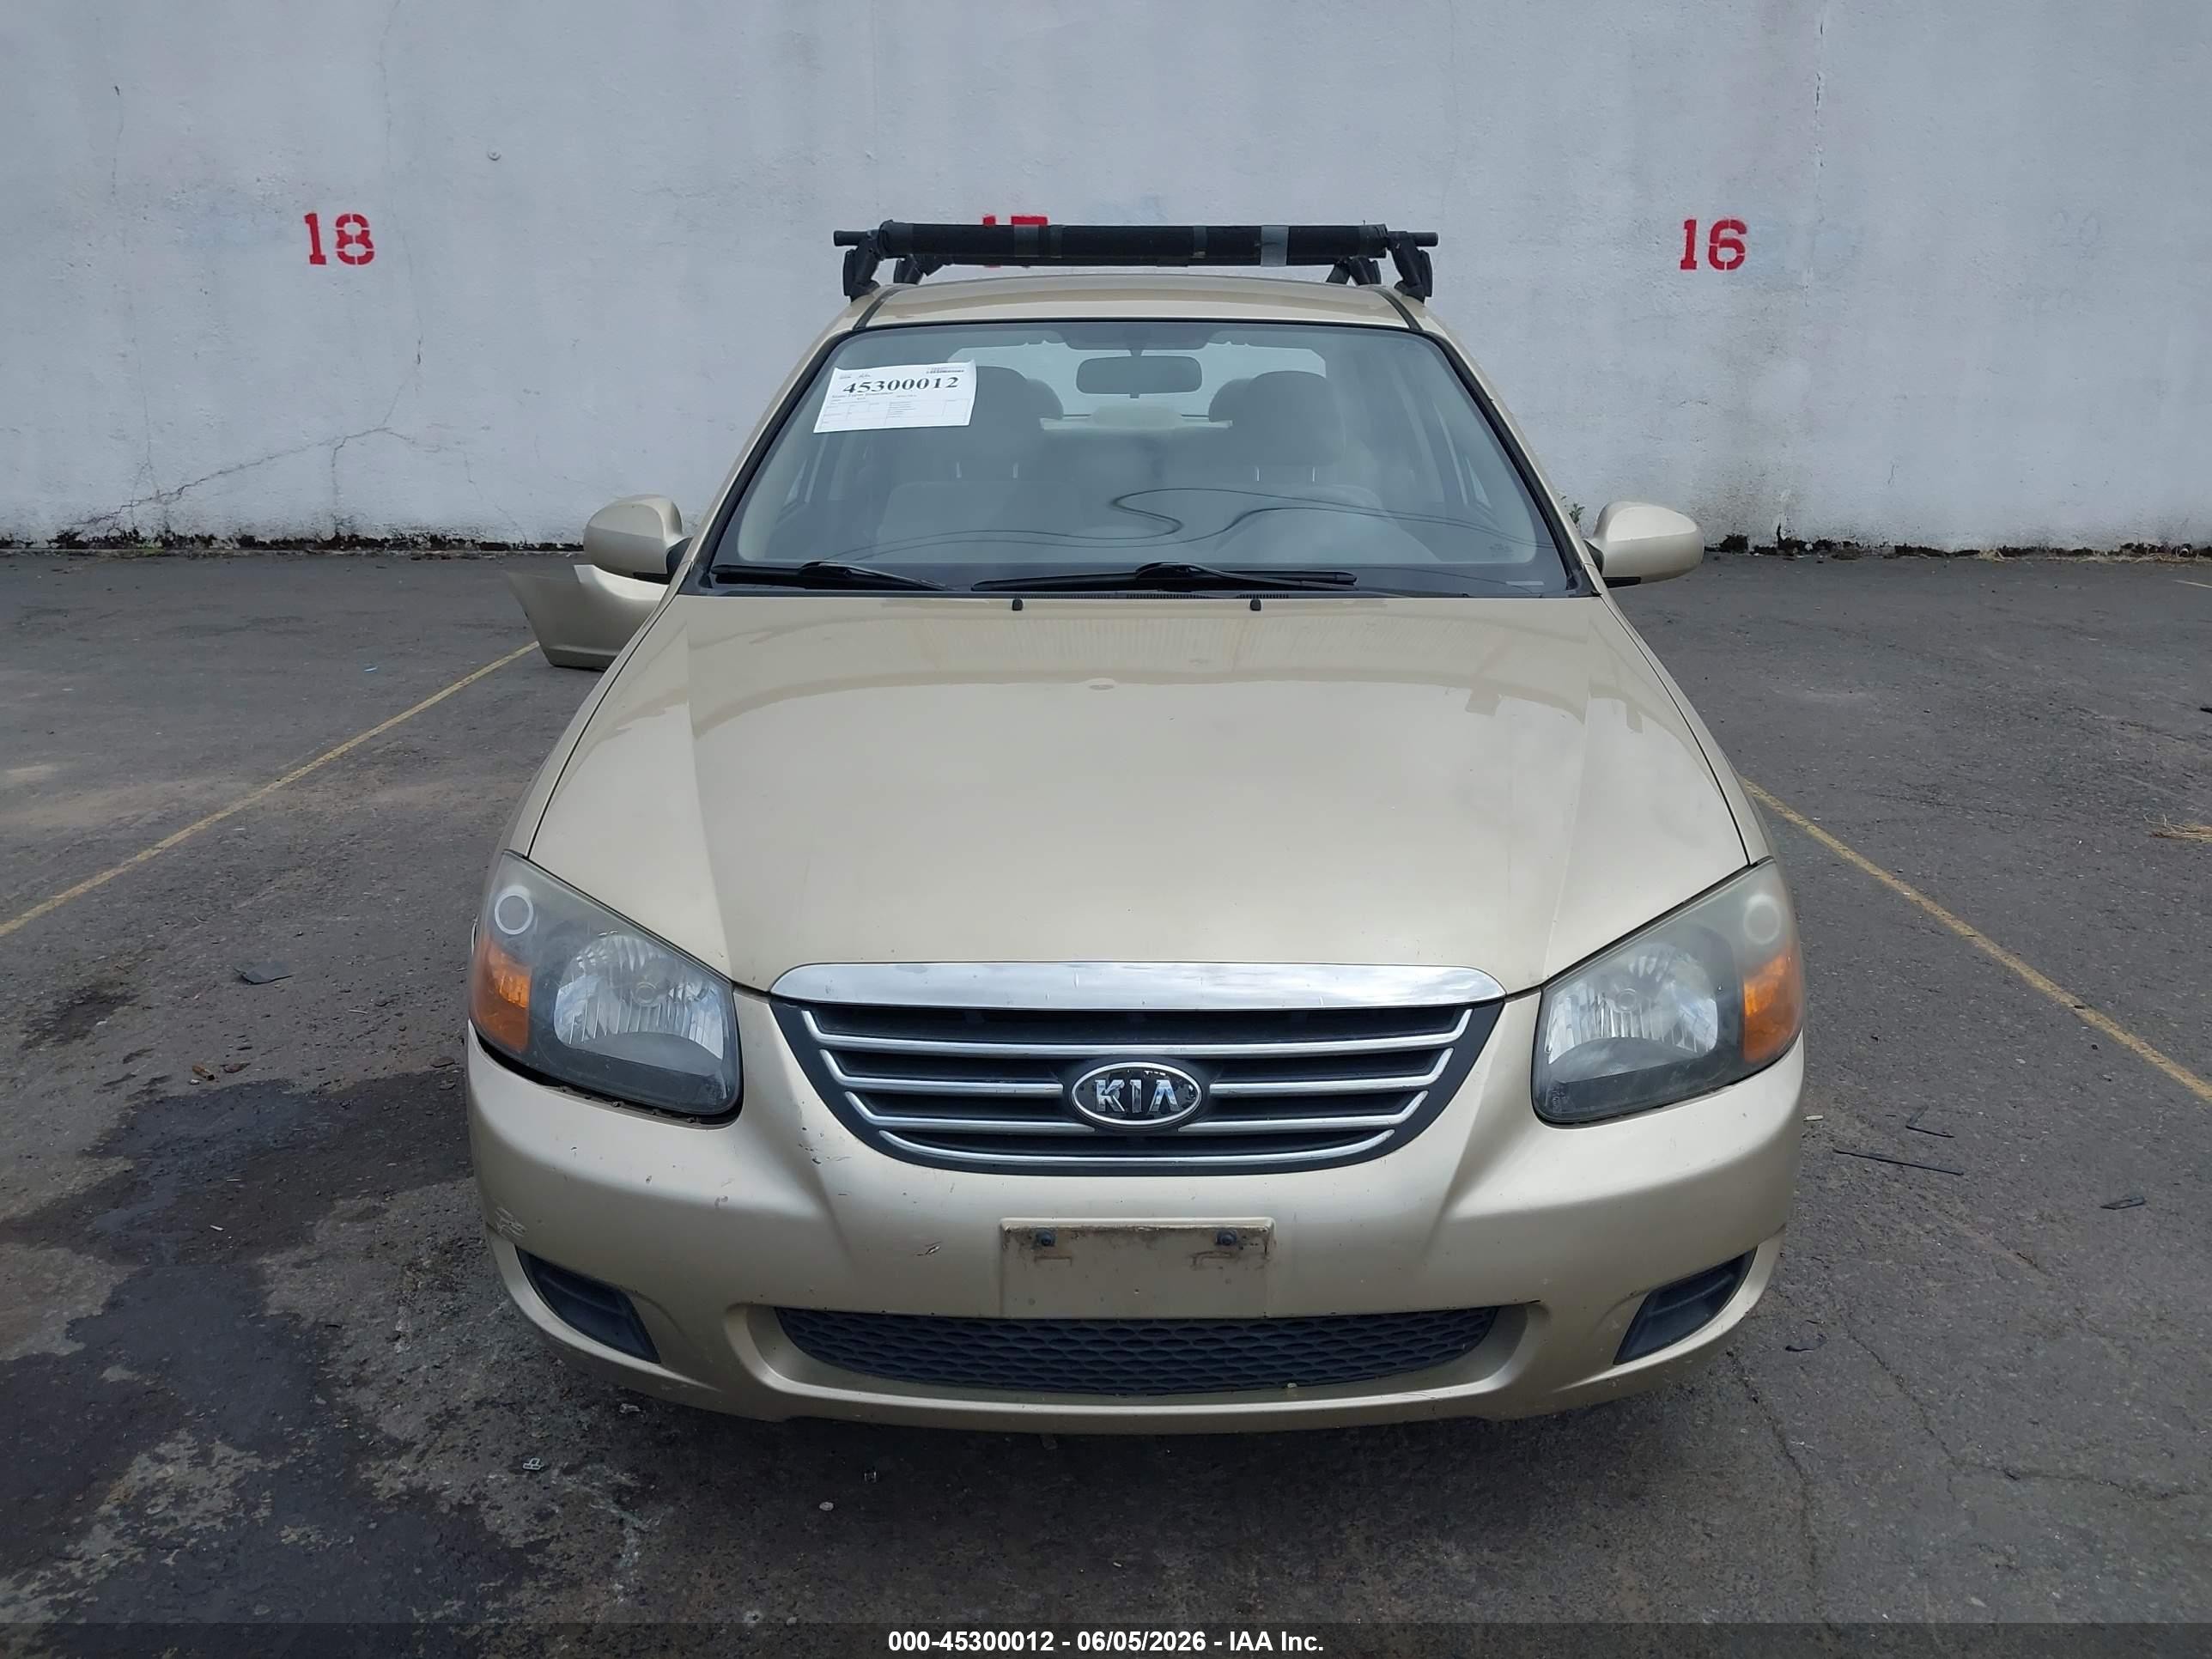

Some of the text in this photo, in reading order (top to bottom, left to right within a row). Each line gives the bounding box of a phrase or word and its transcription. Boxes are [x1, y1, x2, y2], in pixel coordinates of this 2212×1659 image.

[304, 212, 375, 265] 18
[1680, 219, 1747, 270] 16
[843, 377, 959, 393] 45300012
[1094, 1079, 1181, 1113] KIA
